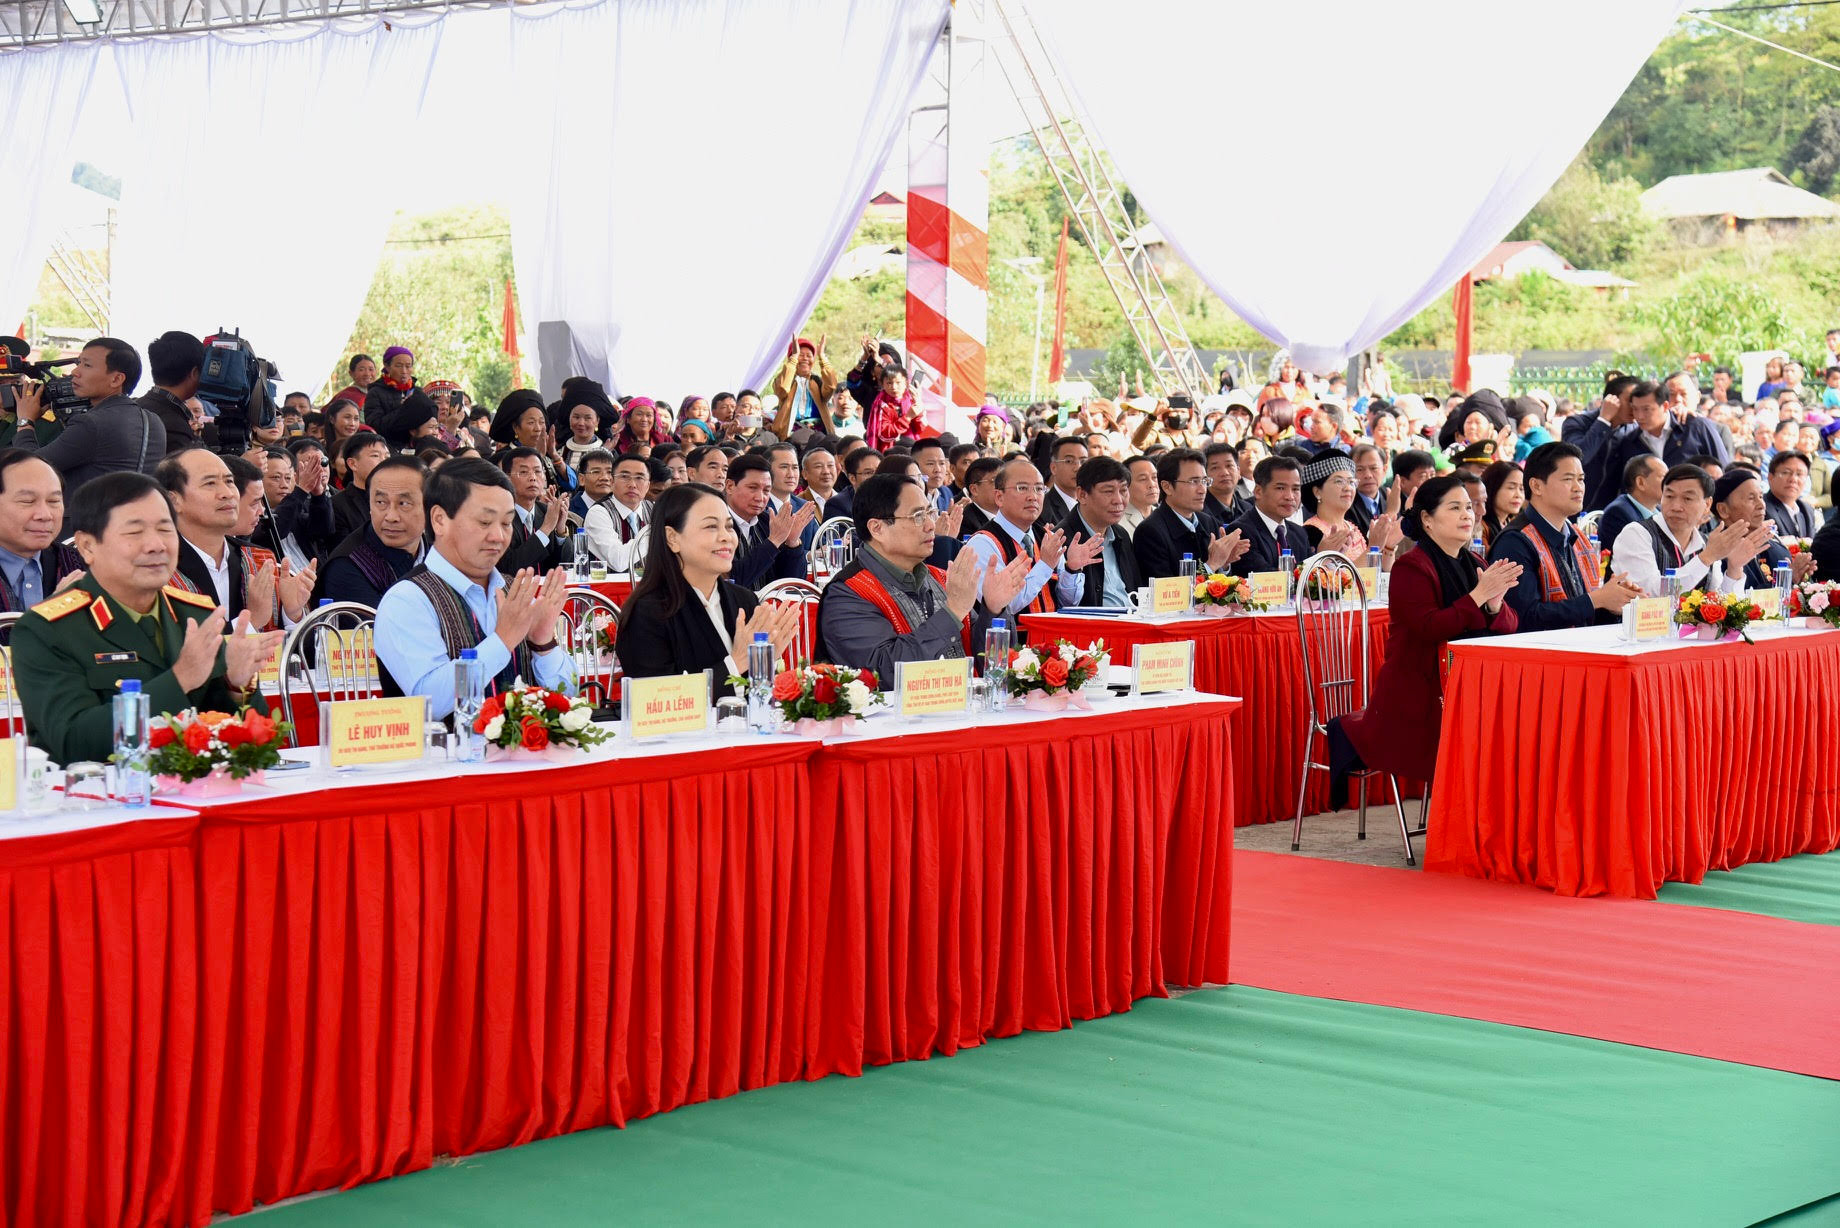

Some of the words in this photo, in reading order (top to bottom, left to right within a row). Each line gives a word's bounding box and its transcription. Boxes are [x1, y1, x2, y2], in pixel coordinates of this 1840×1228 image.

[665, 700, 671, 712] A
[348, 724, 360, 741] LÊ
[363, 725, 383, 740] HUY
[386, 722, 410, 740] VỊNH
